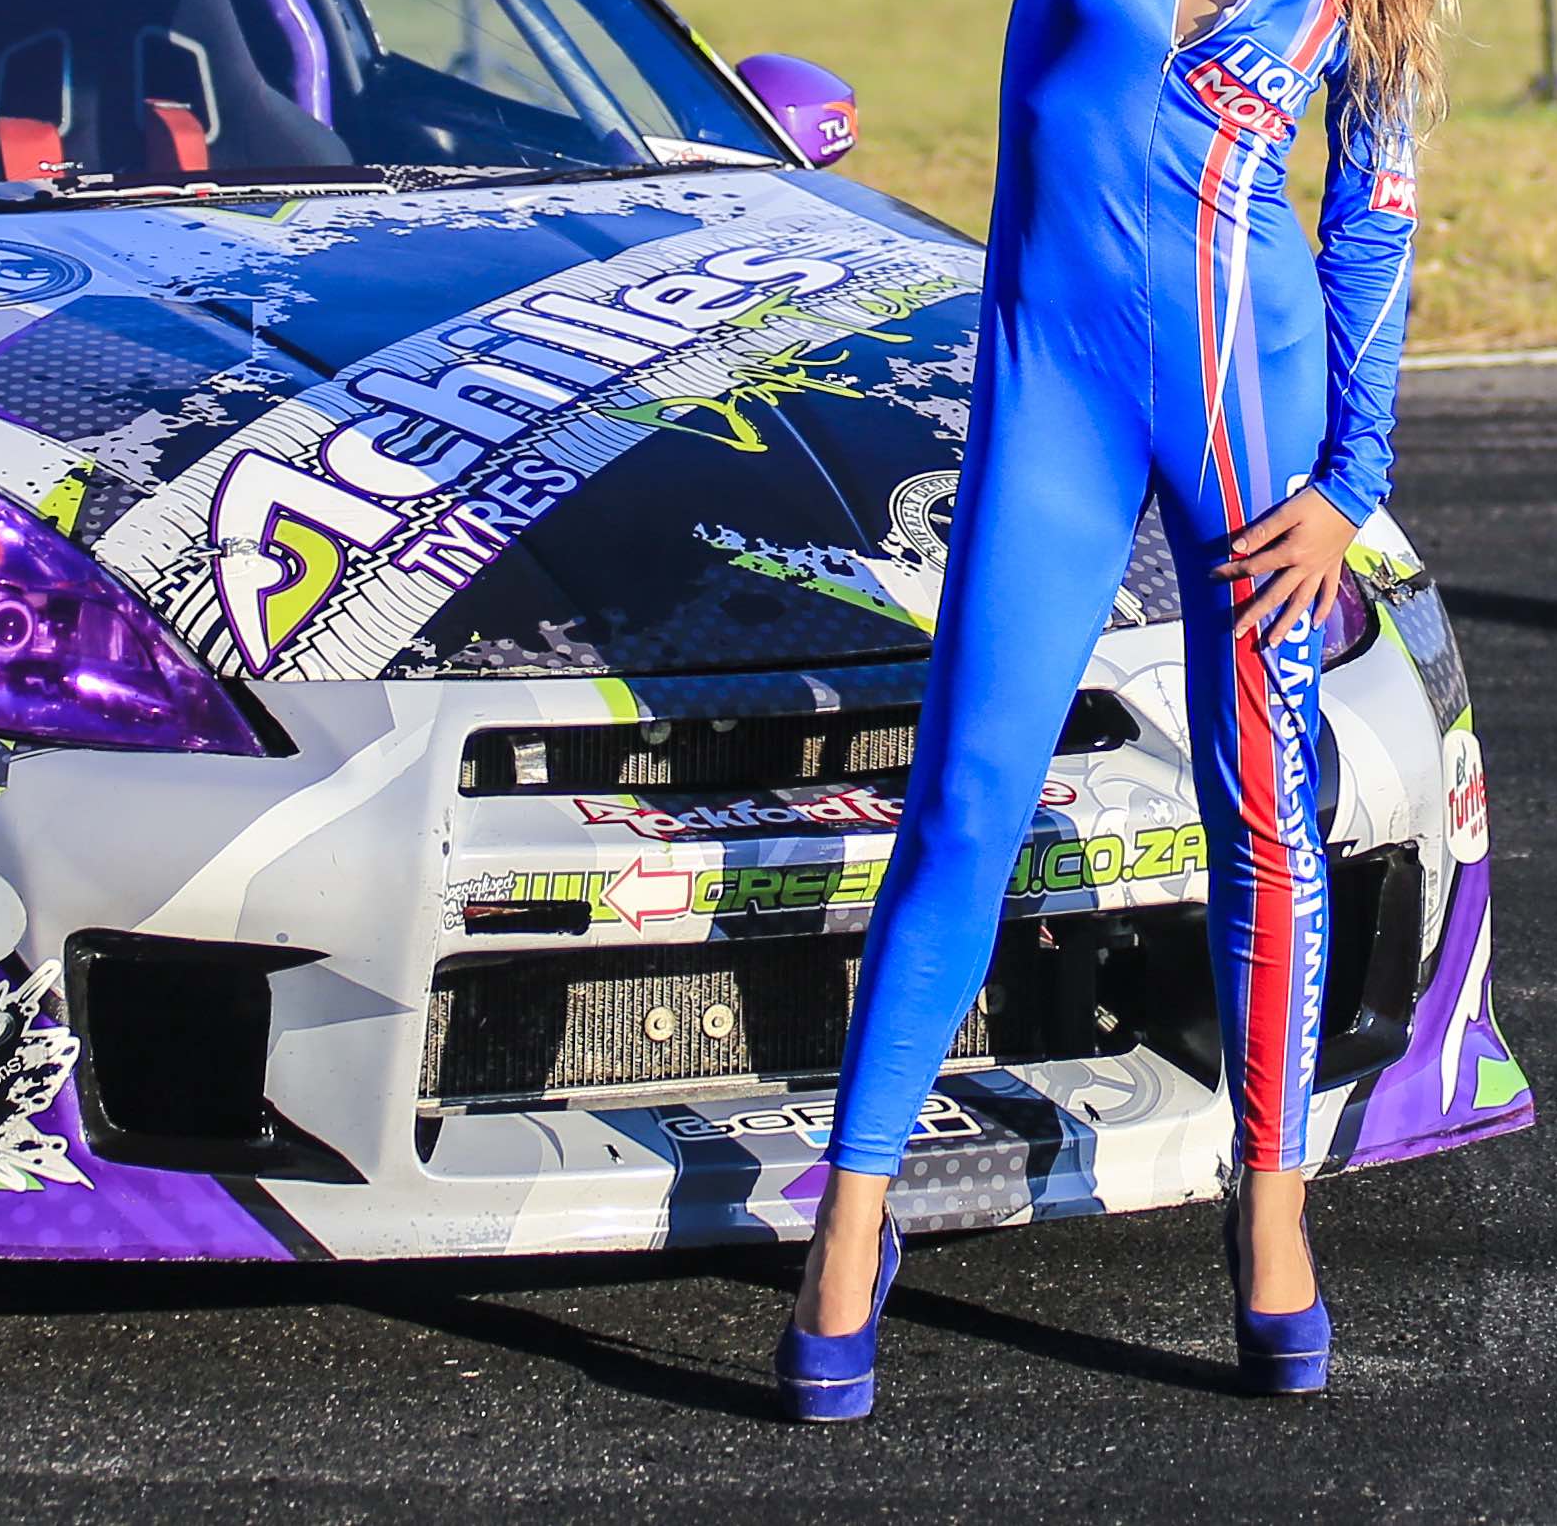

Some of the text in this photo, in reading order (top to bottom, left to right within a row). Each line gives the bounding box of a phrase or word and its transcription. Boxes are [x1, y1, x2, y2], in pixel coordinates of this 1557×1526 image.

[209, 245, 854, 675] Achilles
[396, 454, 582, 591] TYRES
[914, 477, 960, 498] DESIG
